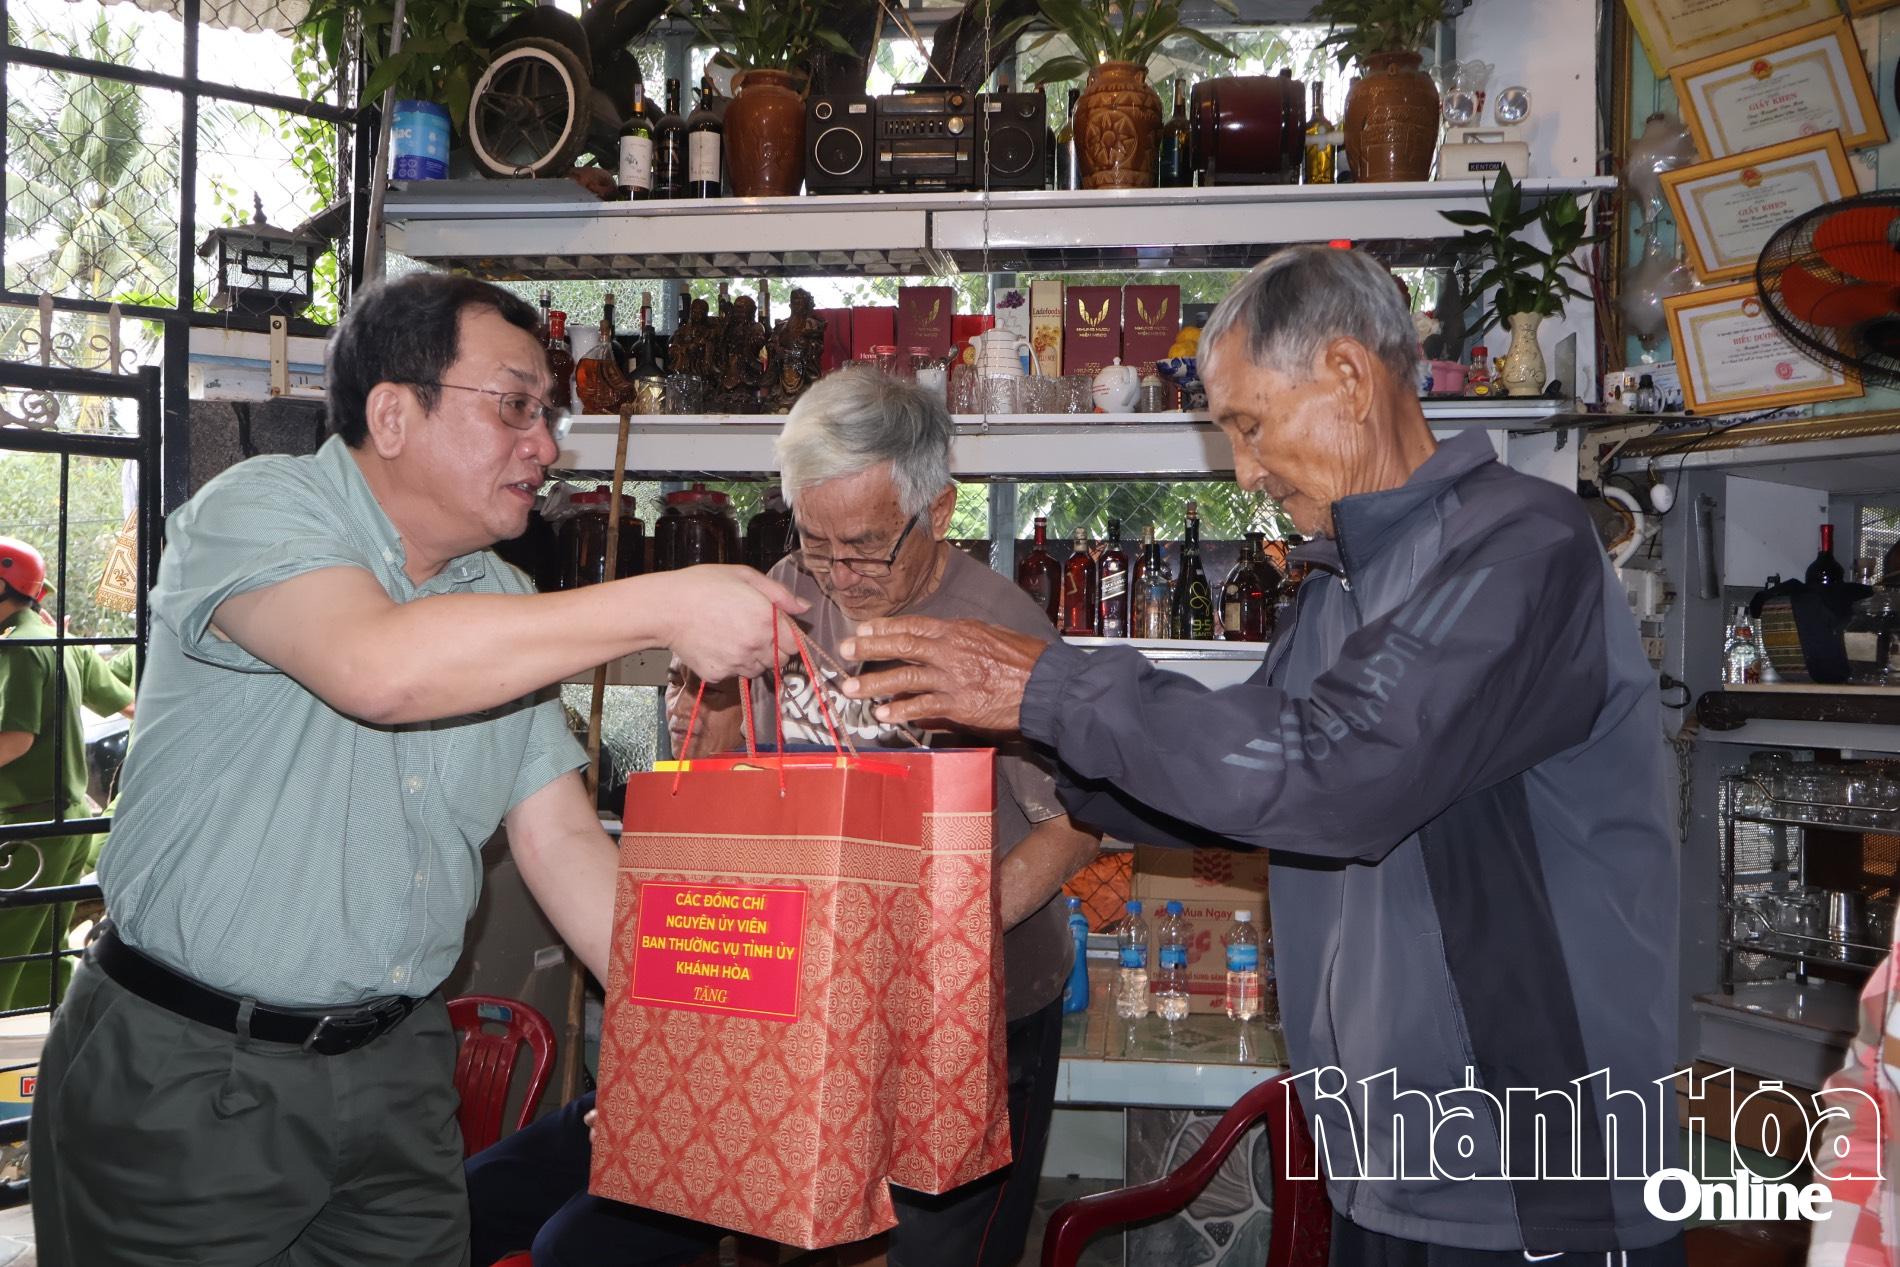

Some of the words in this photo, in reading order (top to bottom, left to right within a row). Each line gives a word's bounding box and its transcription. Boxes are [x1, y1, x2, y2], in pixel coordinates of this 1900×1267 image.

[675, 890, 701, 906] CÁC
[703, 891, 739, 909] ĐỒNG
[742, 894, 766, 910] CHÍ
[666, 914, 715, 931] NGUYÊN
[718, 914, 735, 931] ỦY
[737, 917, 767, 934] VIÊN
[1205, 908, 1233, 921] Ngay
[642, 936, 666, 949] BAN
[668, 937, 719, 954] THƯỜNG
[723, 943, 739, 958] VỤ
[742, 939, 773, 958] TỈNH
[775, 942, 795, 960] ỦY
[676, 960, 719, 977] KHÁNH
[722, 963, 751, 980] HÒA
[693, 986, 728, 1004] TẶNG
